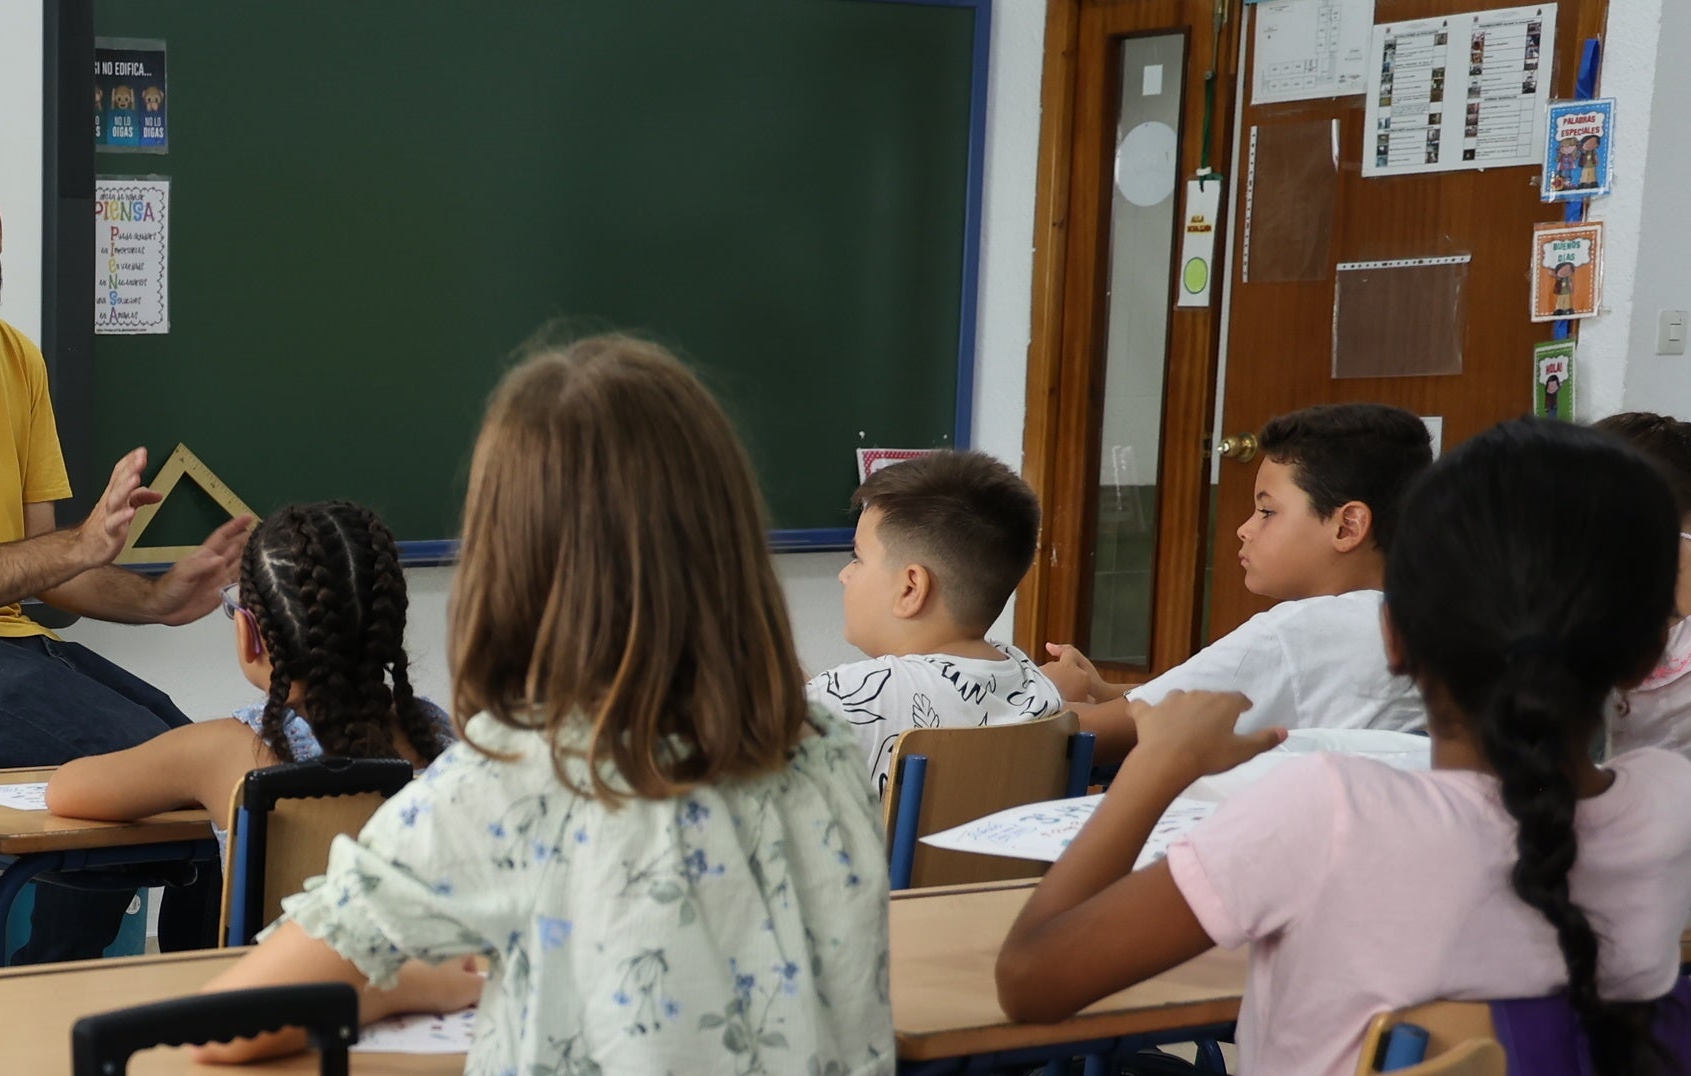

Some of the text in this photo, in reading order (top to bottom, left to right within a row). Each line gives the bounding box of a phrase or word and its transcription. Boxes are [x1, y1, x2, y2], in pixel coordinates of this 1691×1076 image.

[102, 61, 113, 75] NO
[114, 116, 131, 126] NO LO
[145, 117, 162, 127] NO LO
[1563, 115, 1596, 125] PALABRAS
[1560, 126, 1600, 138] ESPECIALES
[1553, 240, 1581, 251] BUENOS
